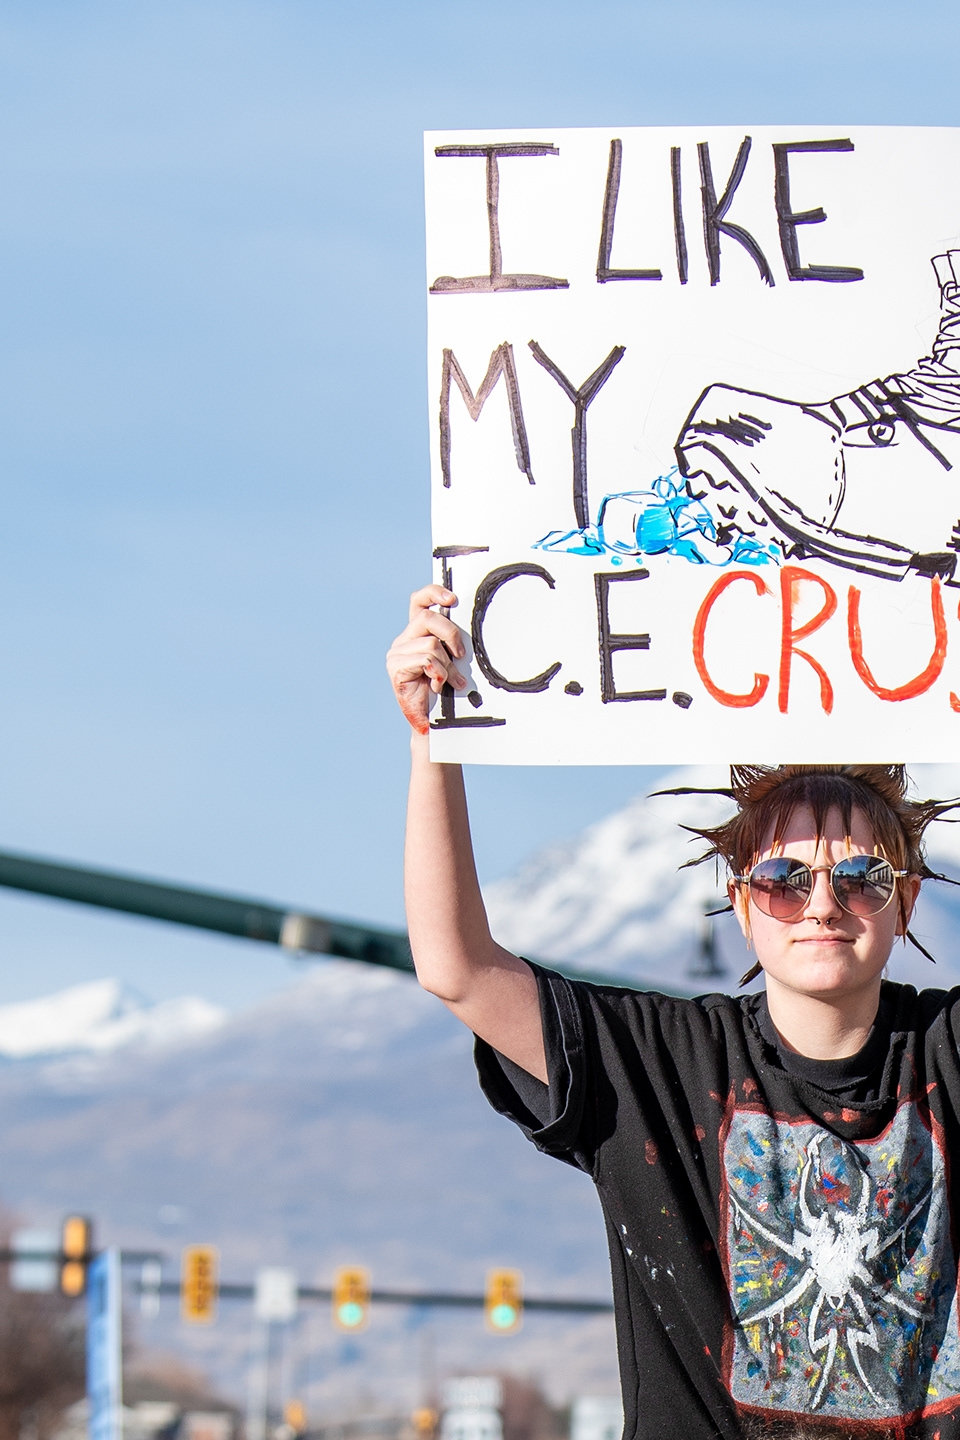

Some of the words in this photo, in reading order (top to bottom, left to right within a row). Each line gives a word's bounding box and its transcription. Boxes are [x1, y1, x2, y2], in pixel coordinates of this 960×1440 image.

[429, 142, 570, 294] I
[596, 135, 865, 287] LIKE
[439, 339, 627, 529] MY
